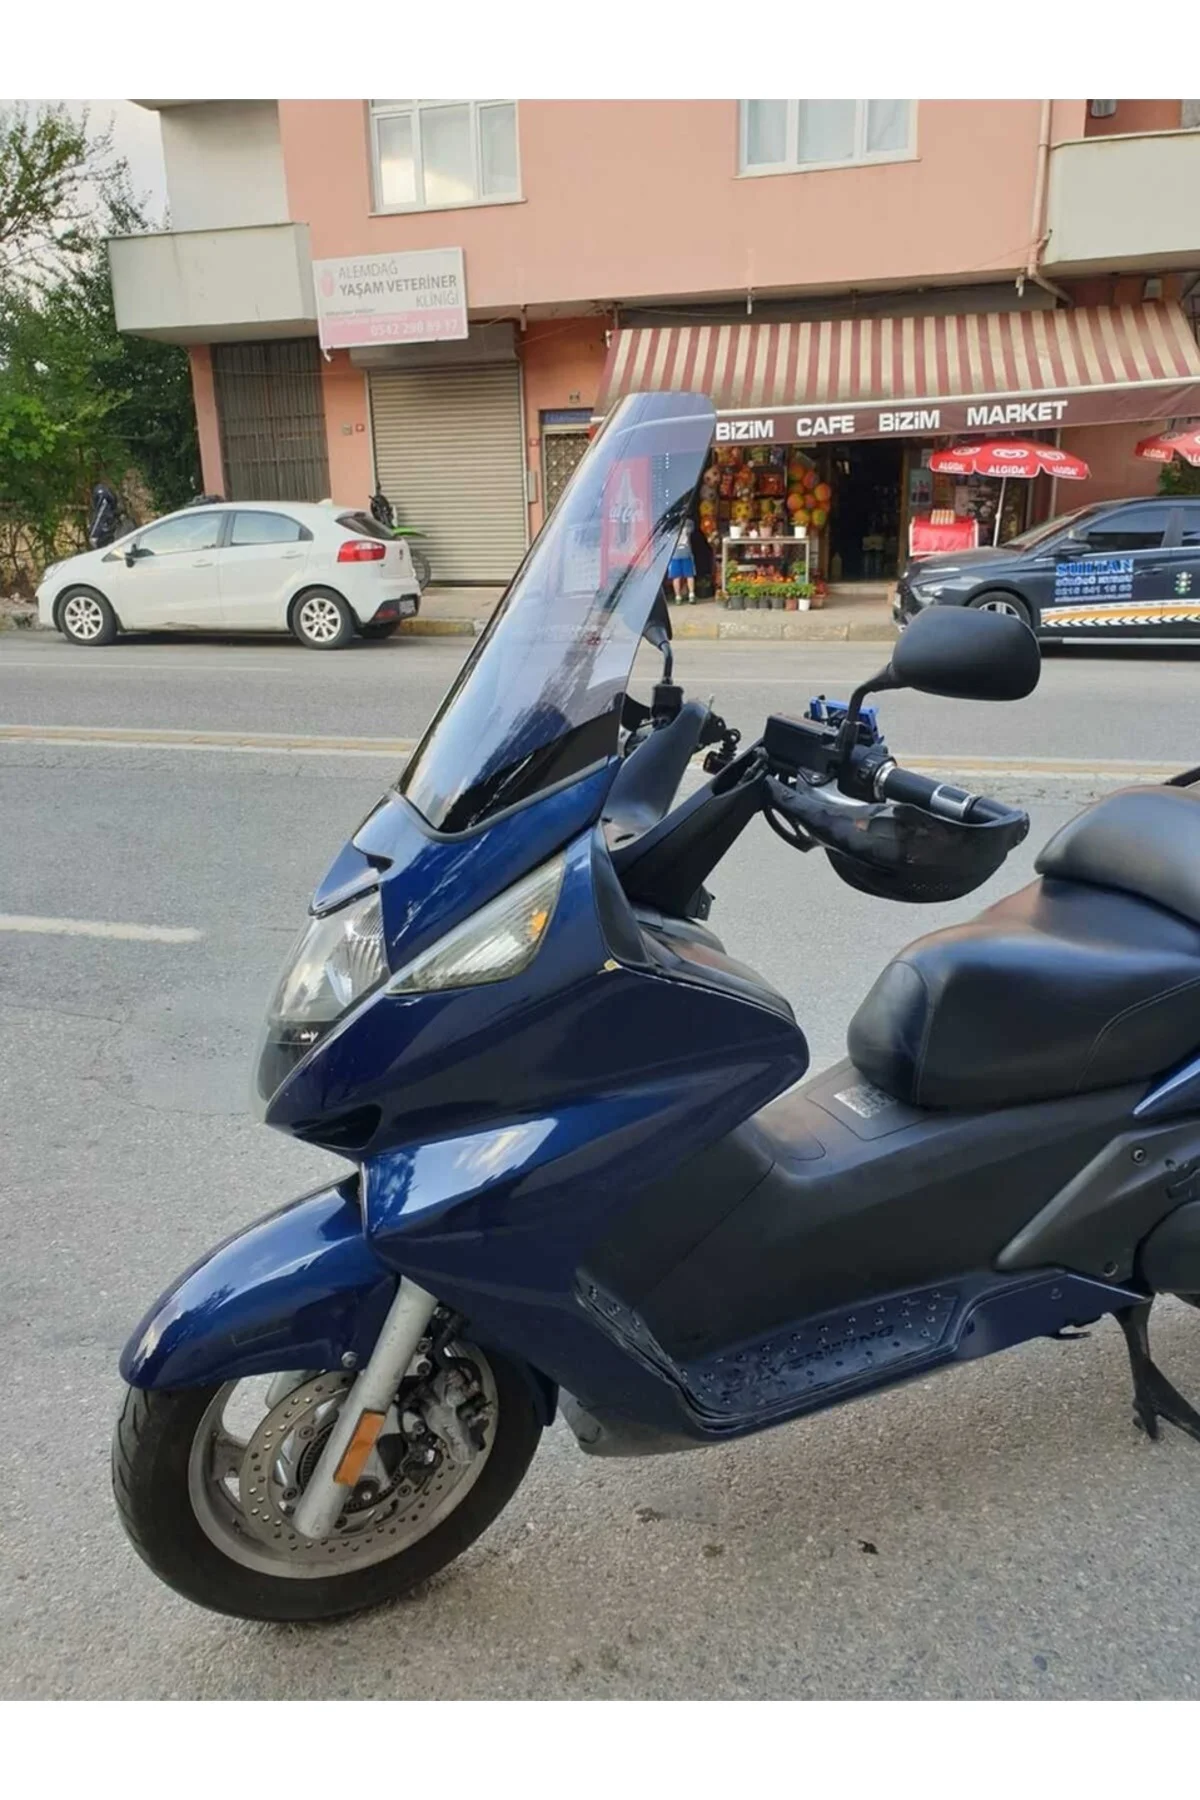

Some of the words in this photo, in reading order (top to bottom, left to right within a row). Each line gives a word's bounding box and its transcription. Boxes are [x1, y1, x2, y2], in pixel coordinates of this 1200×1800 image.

[339, 260, 398, 280] ALEMDAĞ
[340, 282, 385, 298] YAŞAM
[387, 274, 457, 292] VETERİNER
[416, 290, 459, 308] KLİNİĞİ
[796, 415, 855, 437] CAFE
[967, 401, 1068, 426] MARKET
[988, 464, 1026, 474] ALGIDA
[1056, 559, 1134, 577] SULTAN
